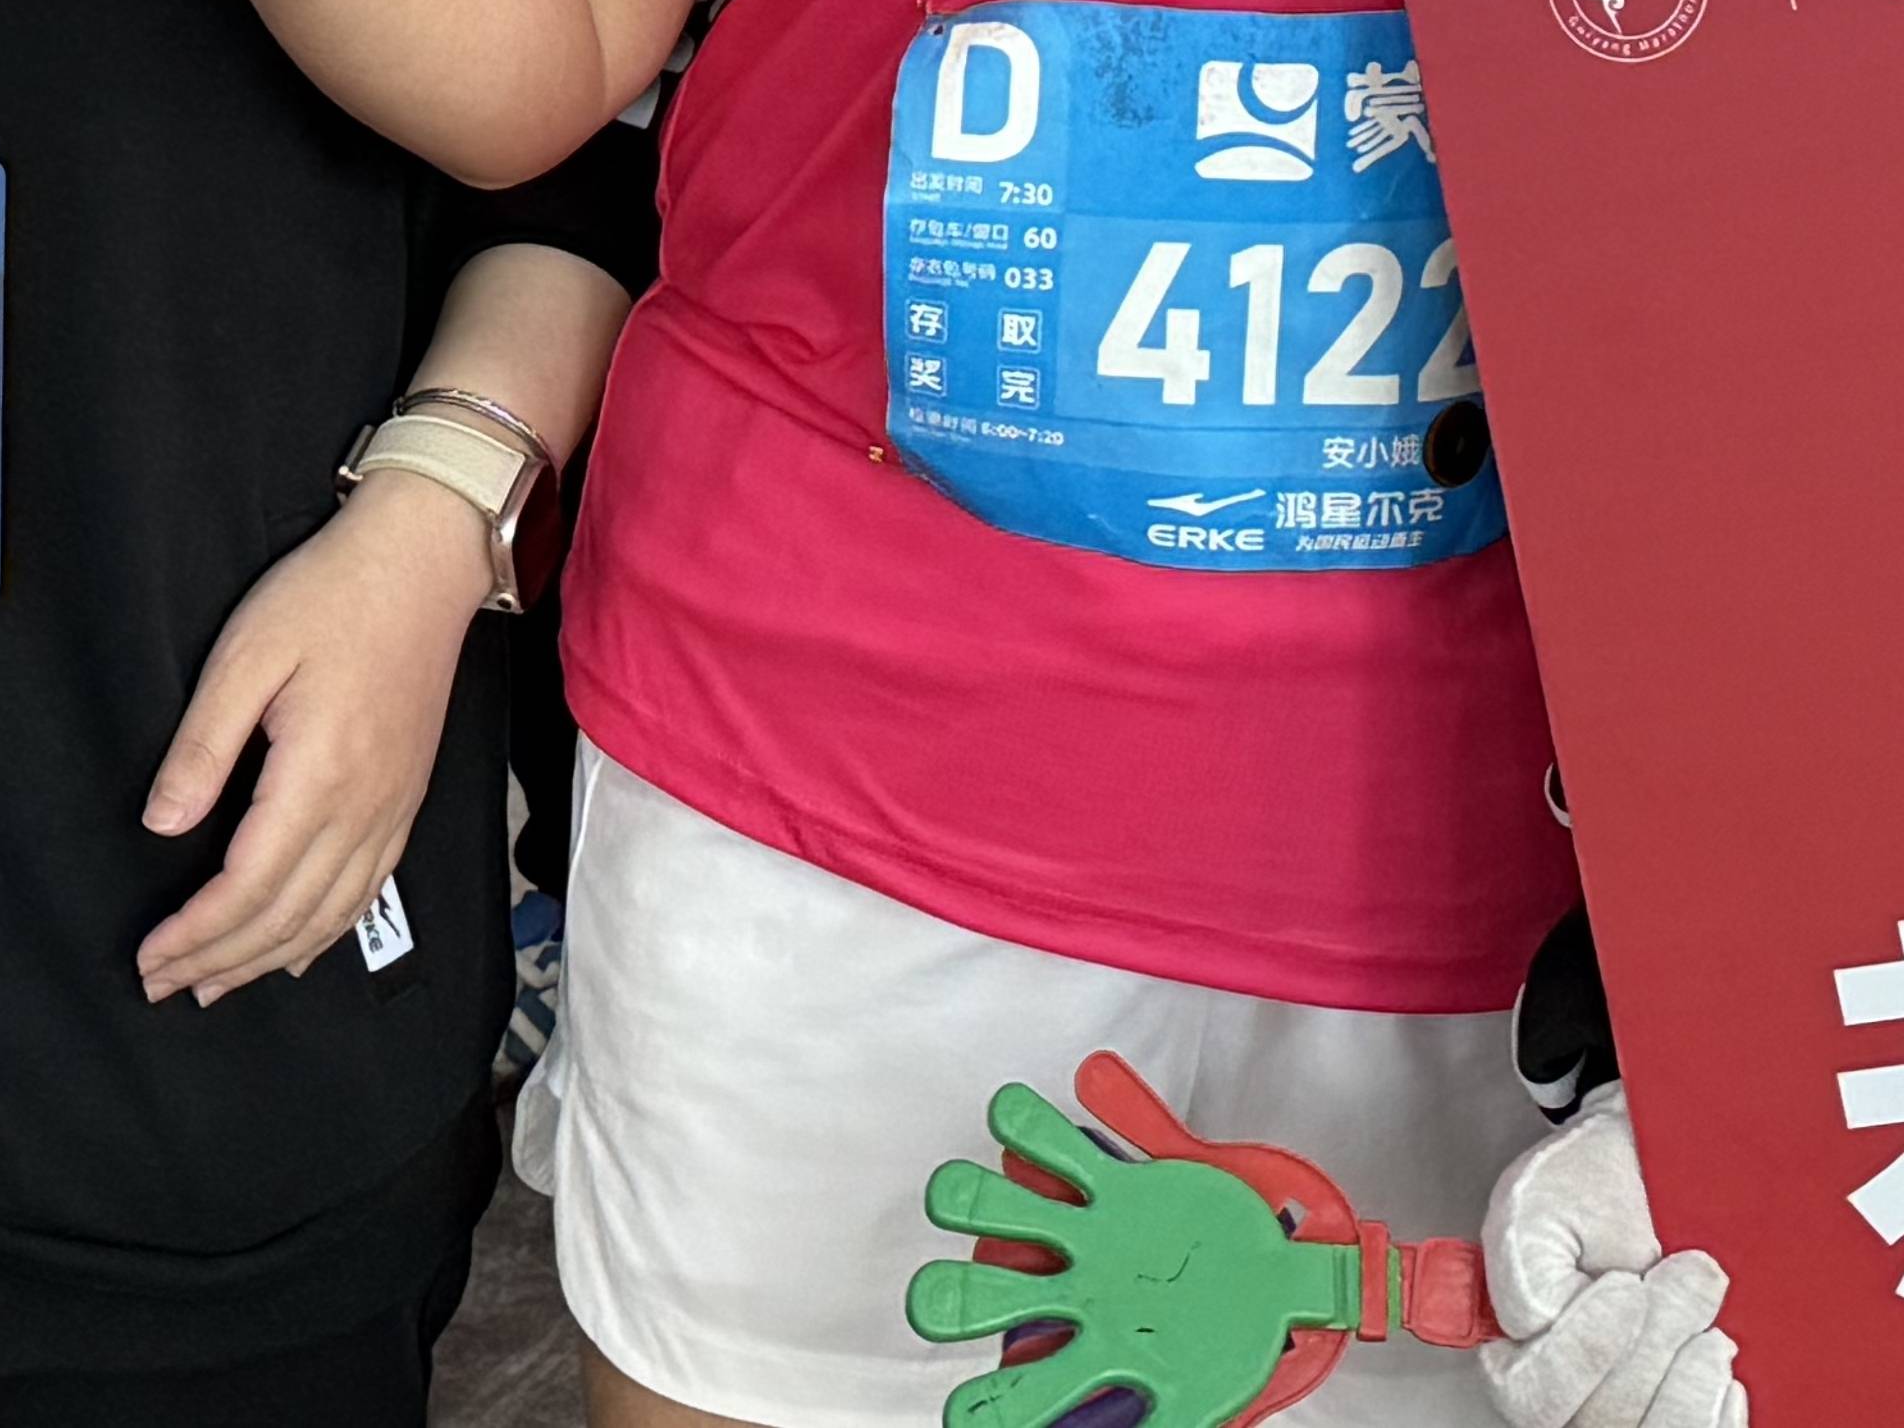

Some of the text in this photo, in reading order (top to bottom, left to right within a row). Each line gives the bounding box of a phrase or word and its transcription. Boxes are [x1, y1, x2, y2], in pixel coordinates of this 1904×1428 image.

[931, 21, 1041, 163] D
[999, 181, 1053, 206] 7:30
[1024, 227, 1057, 249] 60
[1004, 267, 1053, 290] 033
[910, 304, 1037, 346] 存 取
[910, 357, 1036, 403] 奖 完
[1276, 488, 1445, 530] 鸿星尔克
[1147, 524, 1265, 552] ERKE
[362, 908, 384, 955] RKE
